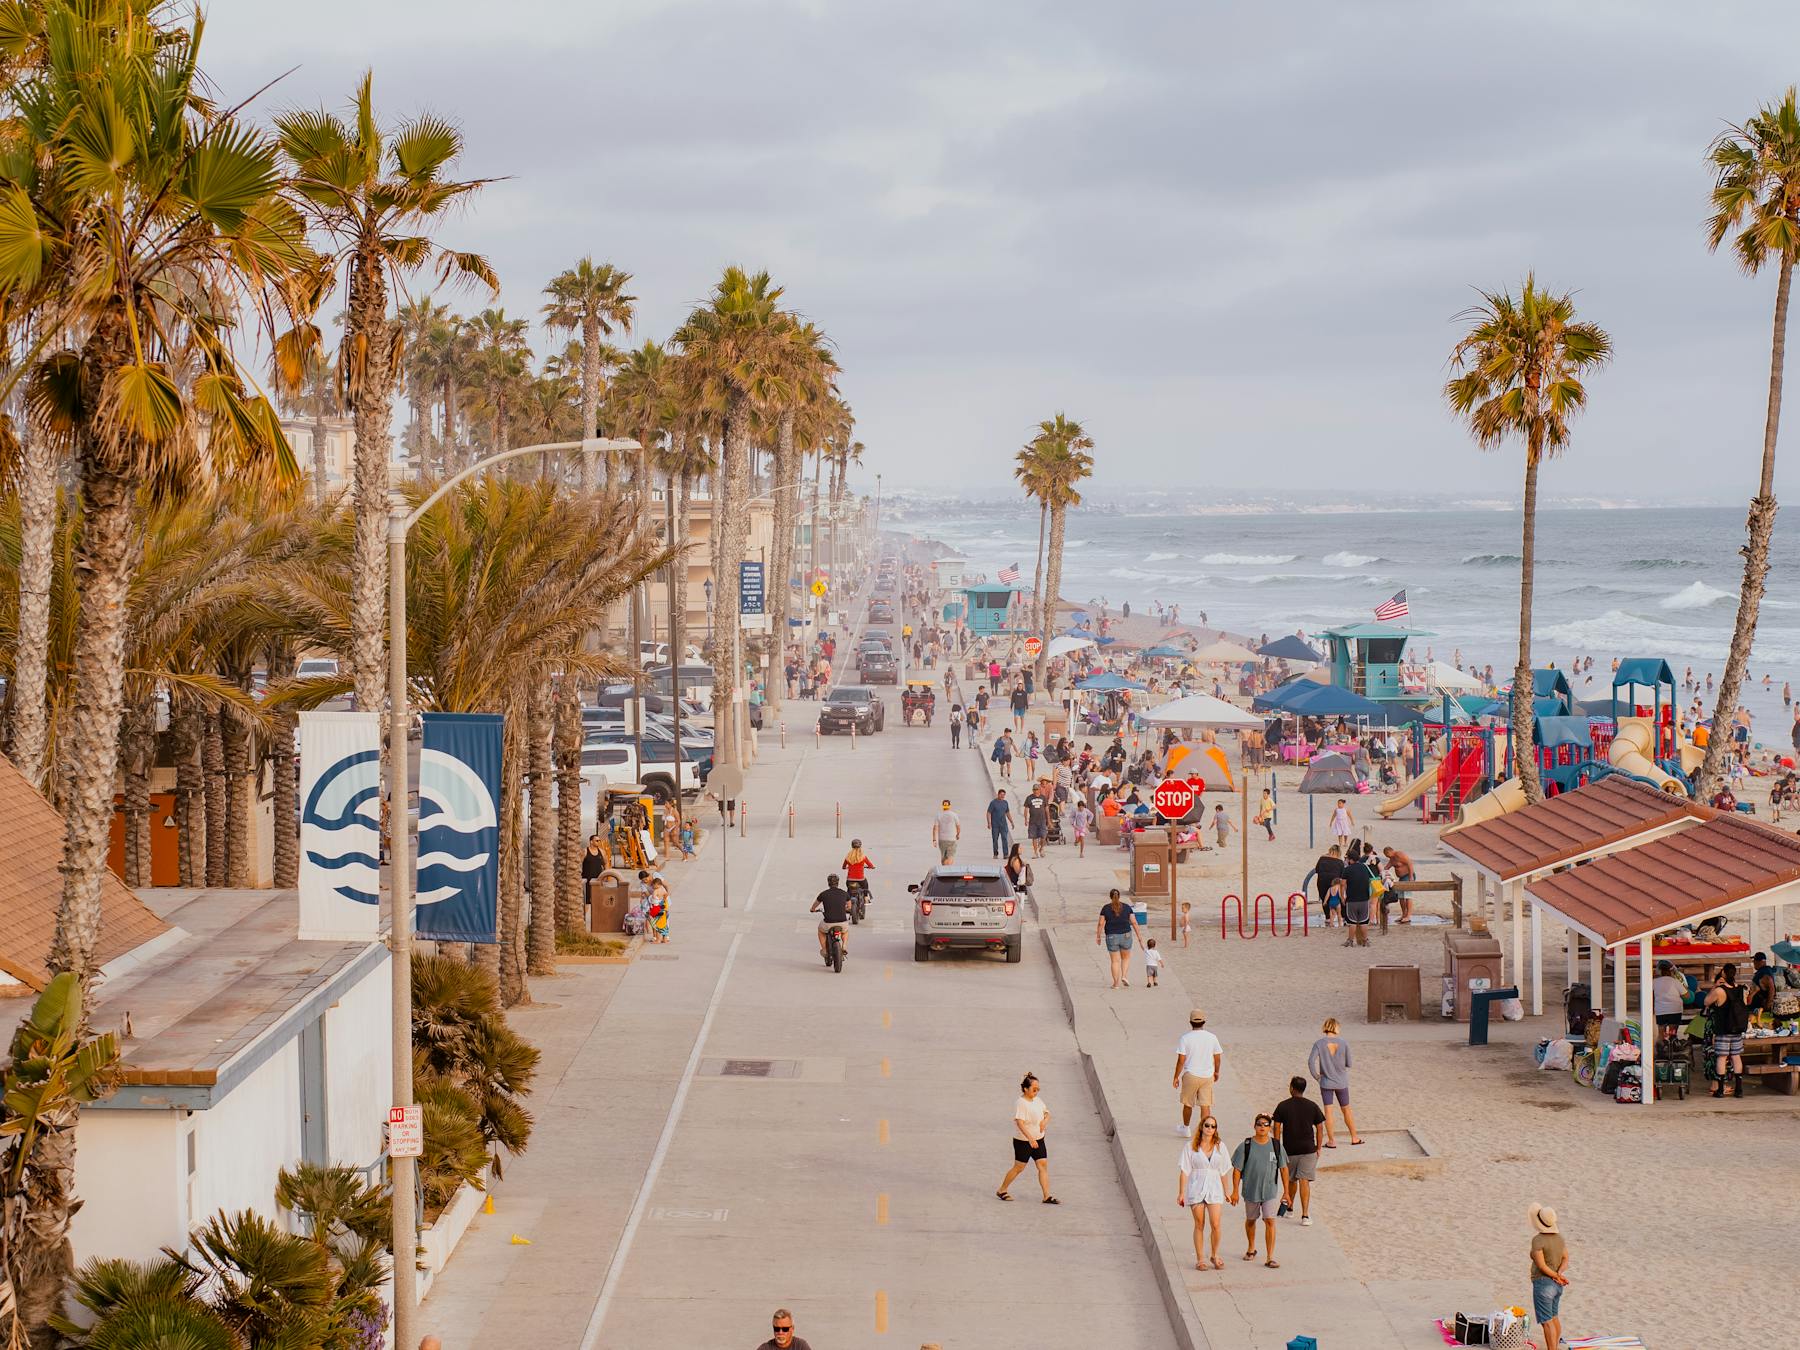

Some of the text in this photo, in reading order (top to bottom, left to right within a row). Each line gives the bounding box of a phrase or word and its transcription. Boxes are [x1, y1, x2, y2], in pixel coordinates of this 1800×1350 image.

[950, 575, 958, 585] 5
[993, 612, 1000, 622] 3
[1025, 642, 1041, 650] STOP
[1379, 669, 1386, 684] 1
[1157, 791, 1191, 806] STOP
[391, 1109, 403, 1121] NO
